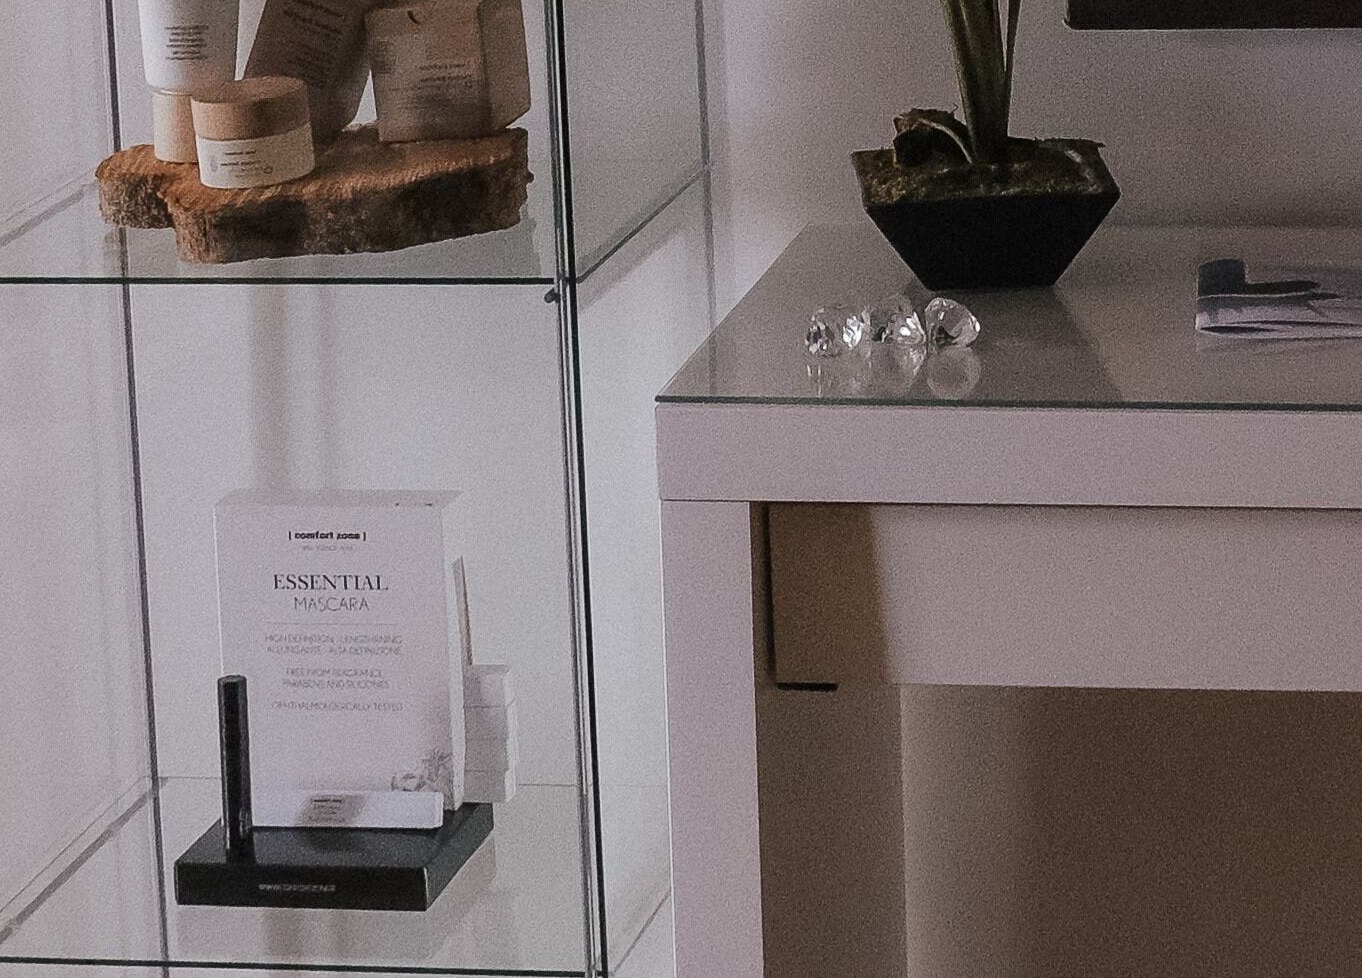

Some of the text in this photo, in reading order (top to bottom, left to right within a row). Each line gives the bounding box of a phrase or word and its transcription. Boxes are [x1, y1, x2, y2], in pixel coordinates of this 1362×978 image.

[294, 530, 334, 540] comfort
[336, 532, 361, 540] zone
[273, 573, 389, 591] ESSENTIAL
[293, 596, 371, 612] MASCARA
